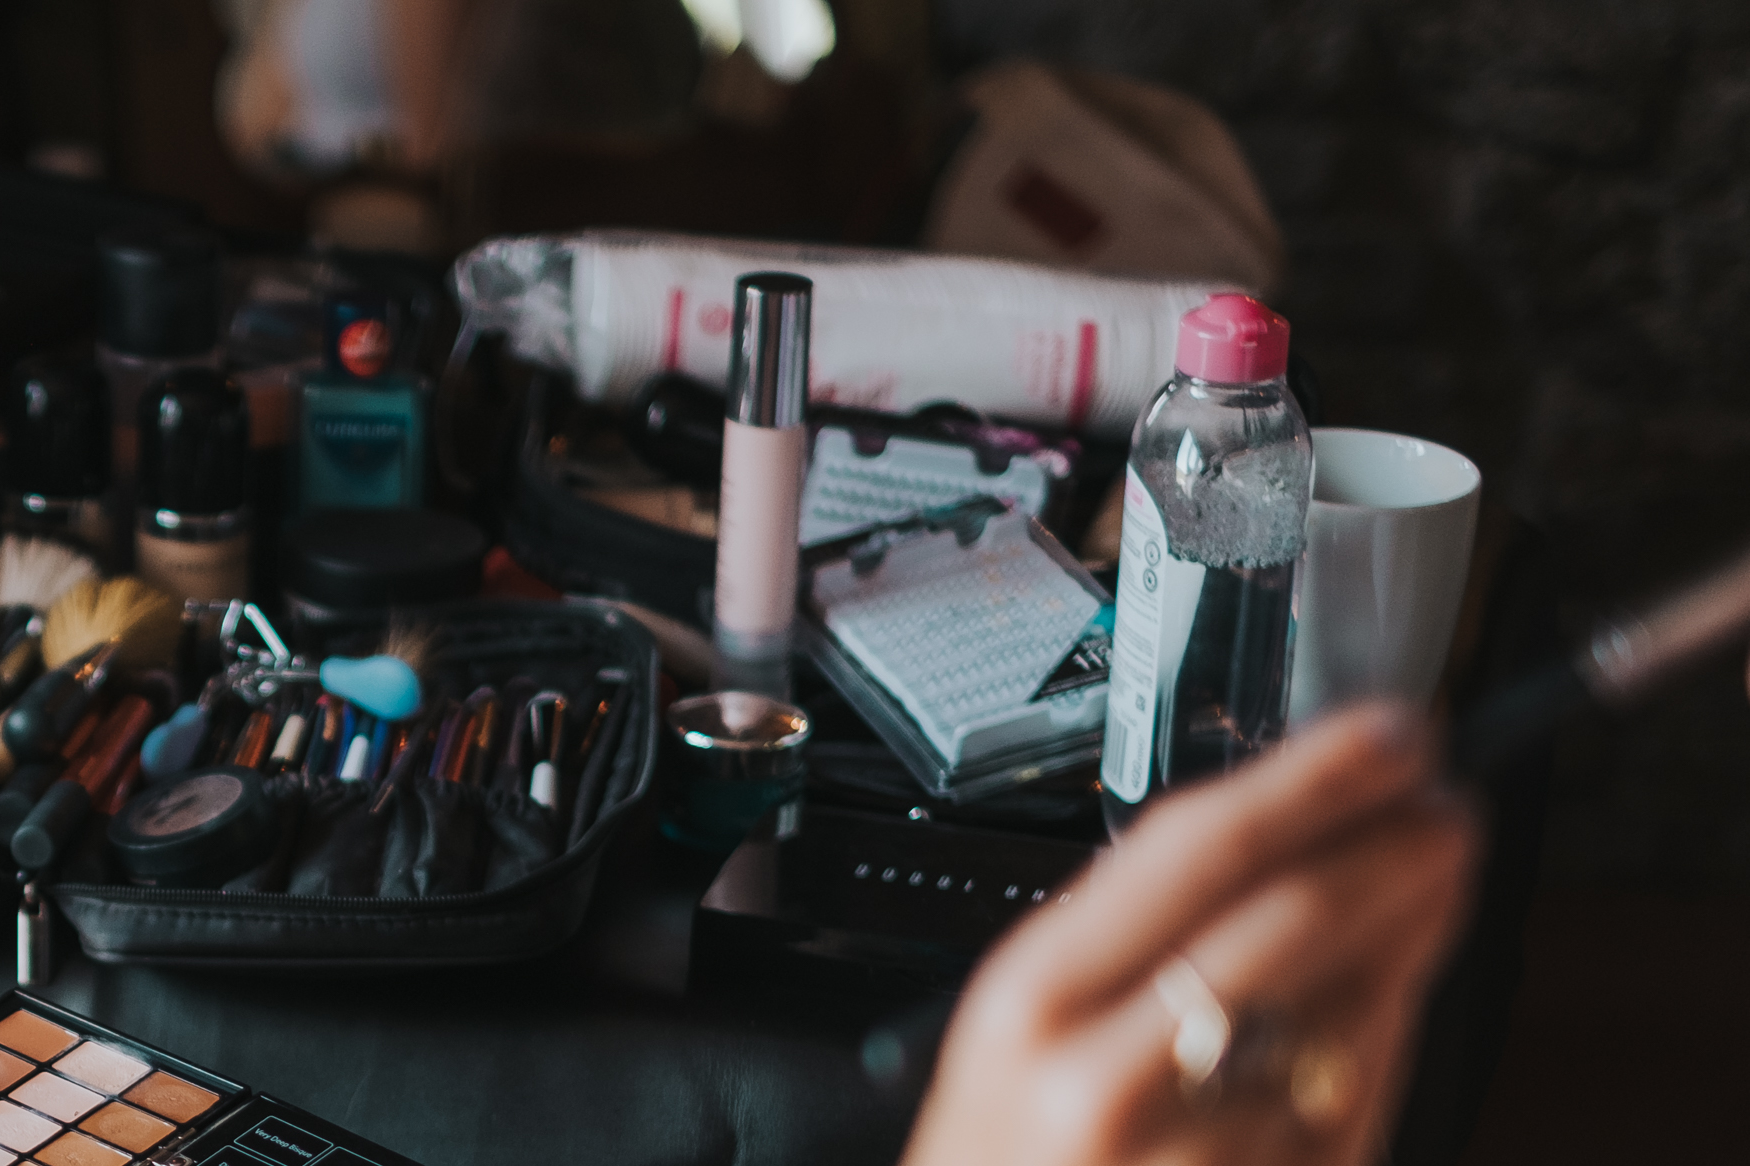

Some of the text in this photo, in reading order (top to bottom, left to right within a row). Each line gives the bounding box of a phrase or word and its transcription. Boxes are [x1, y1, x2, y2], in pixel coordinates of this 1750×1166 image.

[254, 1128, 313, 1159] Very Deep Bisque
